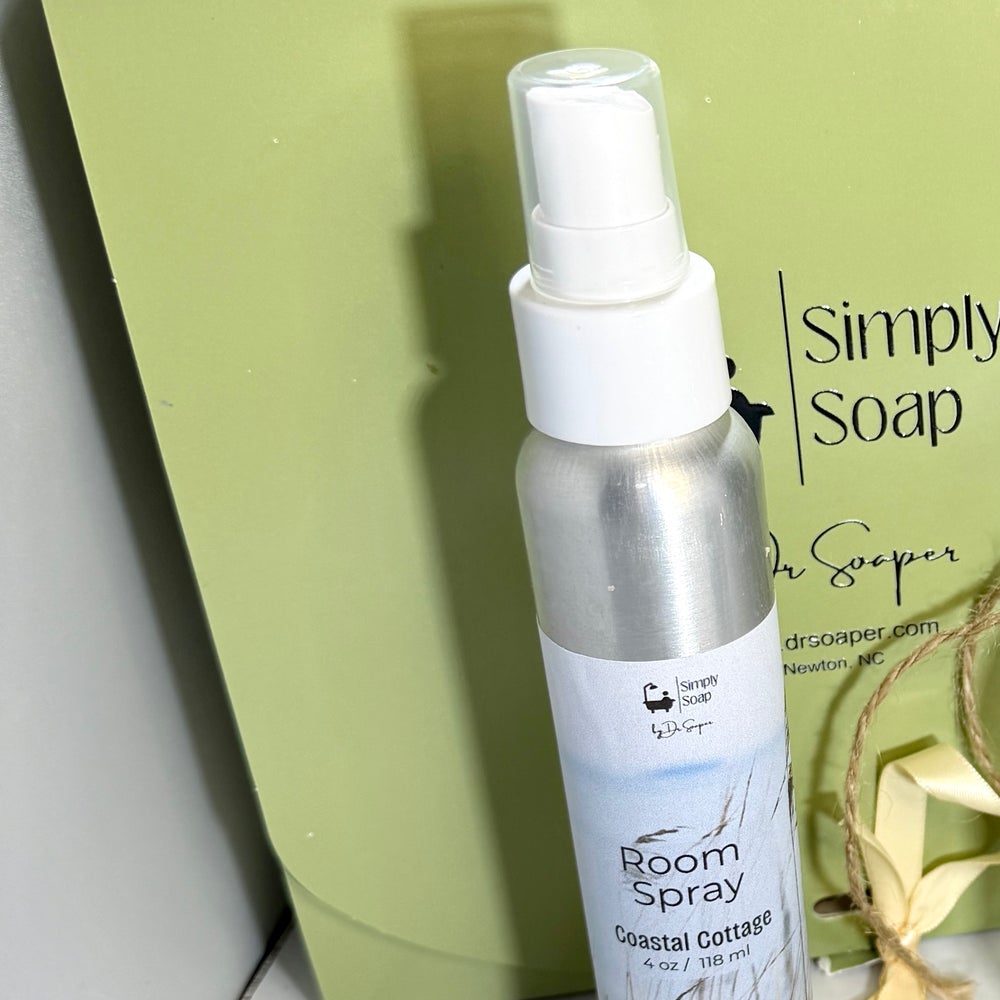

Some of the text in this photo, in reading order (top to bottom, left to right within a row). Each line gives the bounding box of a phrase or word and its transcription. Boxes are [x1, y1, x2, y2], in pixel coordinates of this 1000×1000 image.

[811, 386, 963, 447] Soap
[811, 519, 960, 606] Soaper
[858, 652, 885, 666] NC
[680, 674, 719, 692] Simply
[682, 691, 712, 706] Soap
[620, 843, 739, 875] Room
[633, 872, 744, 913] Spray
[615, 909, 772, 951] Coastal Cottage
[643, 958, 654, 969] 4
[699, 954, 724, 969] 118
[729, 944, 751, 962] ml
